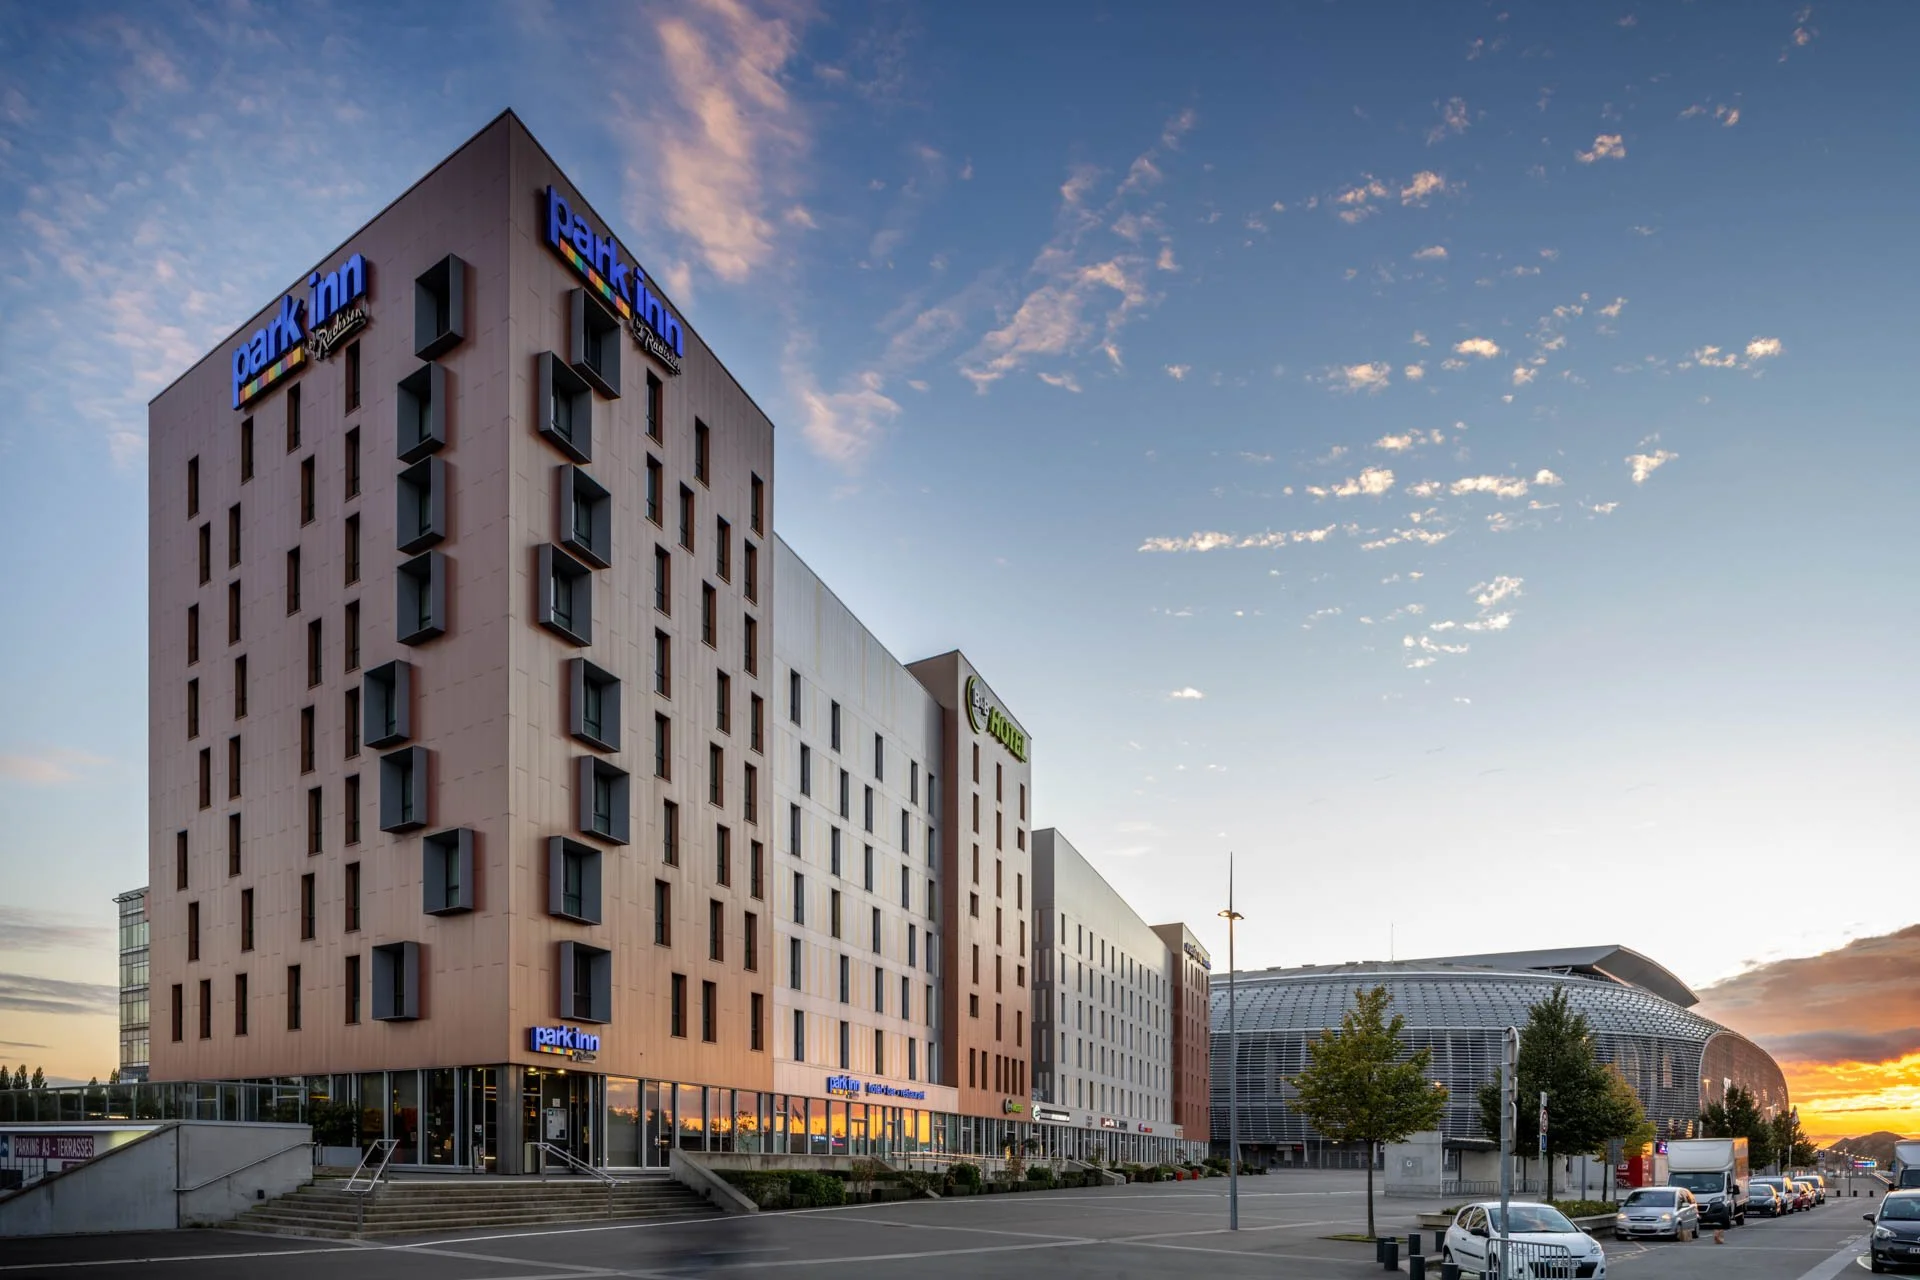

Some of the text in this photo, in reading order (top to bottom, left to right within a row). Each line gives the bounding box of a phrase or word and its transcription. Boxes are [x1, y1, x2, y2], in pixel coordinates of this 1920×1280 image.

[547, 186, 684, 358] park inn
[232, 253, 366, 411] park inn
[317, 308, 362, 359] Radisson
[988, 706, 1028, 763] HOTEL
[532, 1025, 600, 1052] park inn
[828, 1075, 860, 1093] park inn
[15, 1137, 40, 1156] PARKING
[41, 1138, 50, 1156] A3
[56, 1138, 94, 1157] TERRASSES
